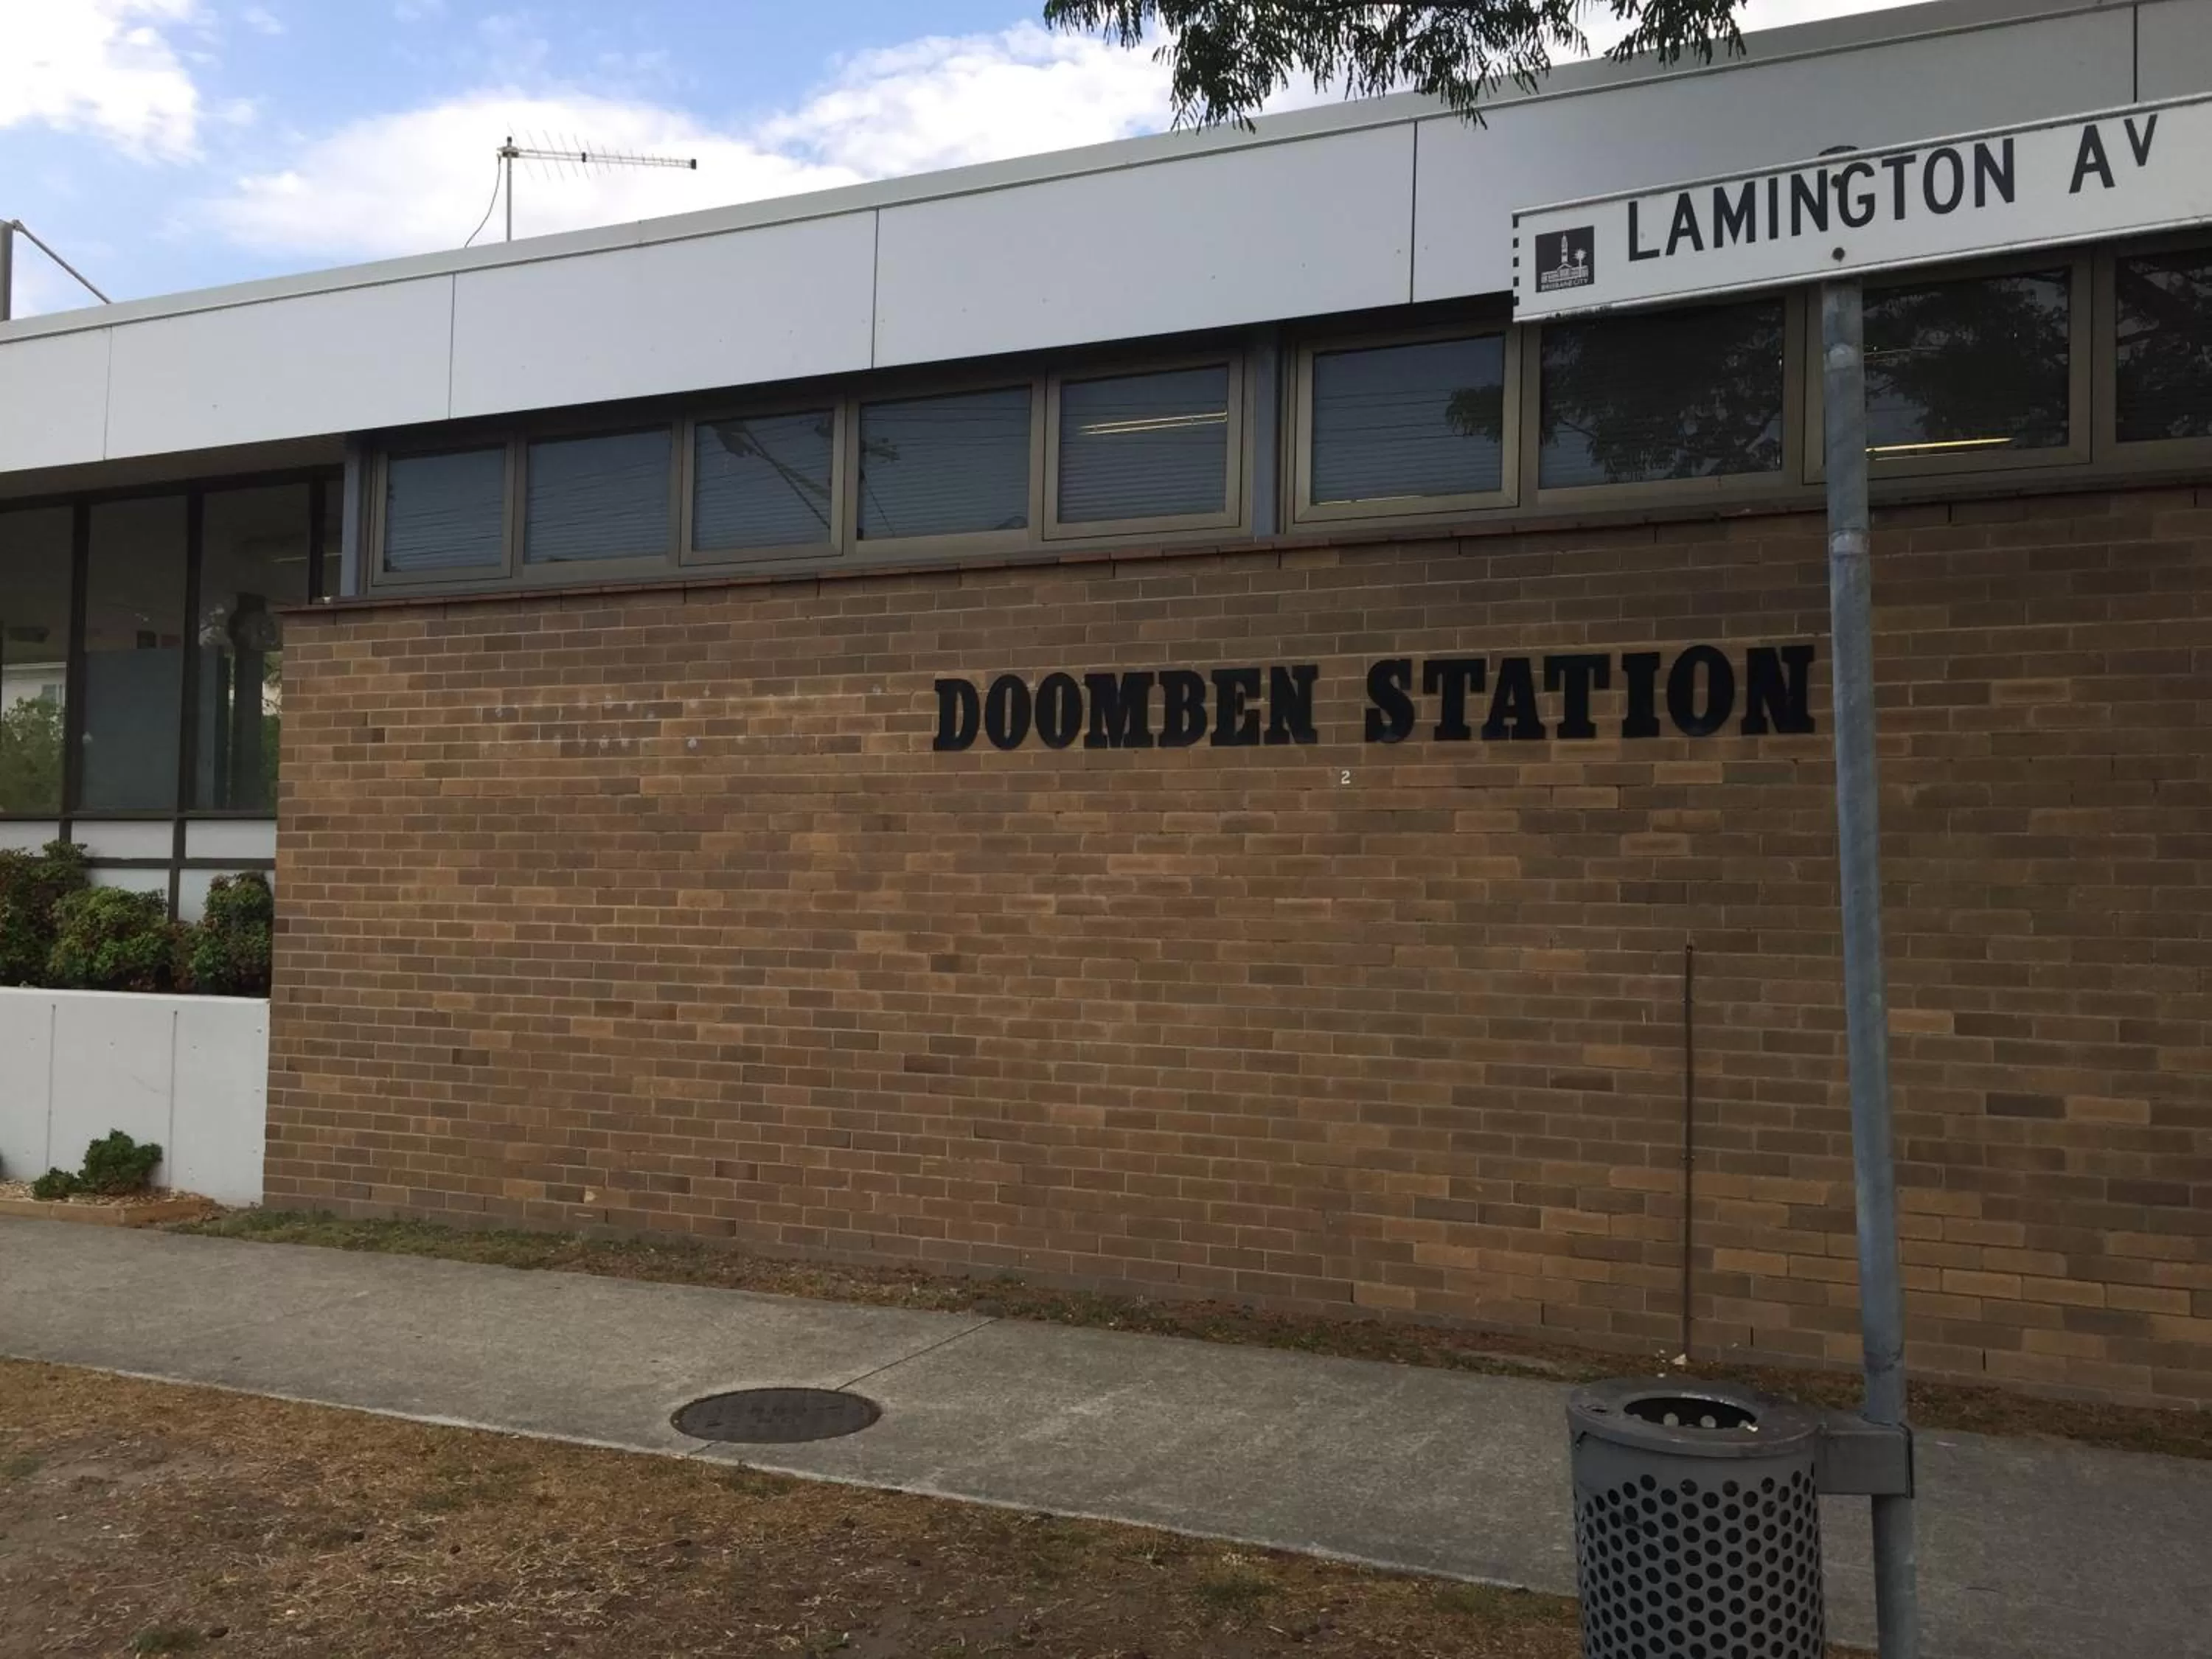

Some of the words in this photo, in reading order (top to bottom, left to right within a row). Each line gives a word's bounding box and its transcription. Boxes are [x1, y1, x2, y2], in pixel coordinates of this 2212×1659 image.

[1627, 137, 2015, 262] LAMINGTON
[2069, 114, 2158, 194] AV
[933, 664, 1319, 751] DOOMBEN
[1364, 644, 1817, 744] STATION
[1340, 769, 1352, 785] 2
